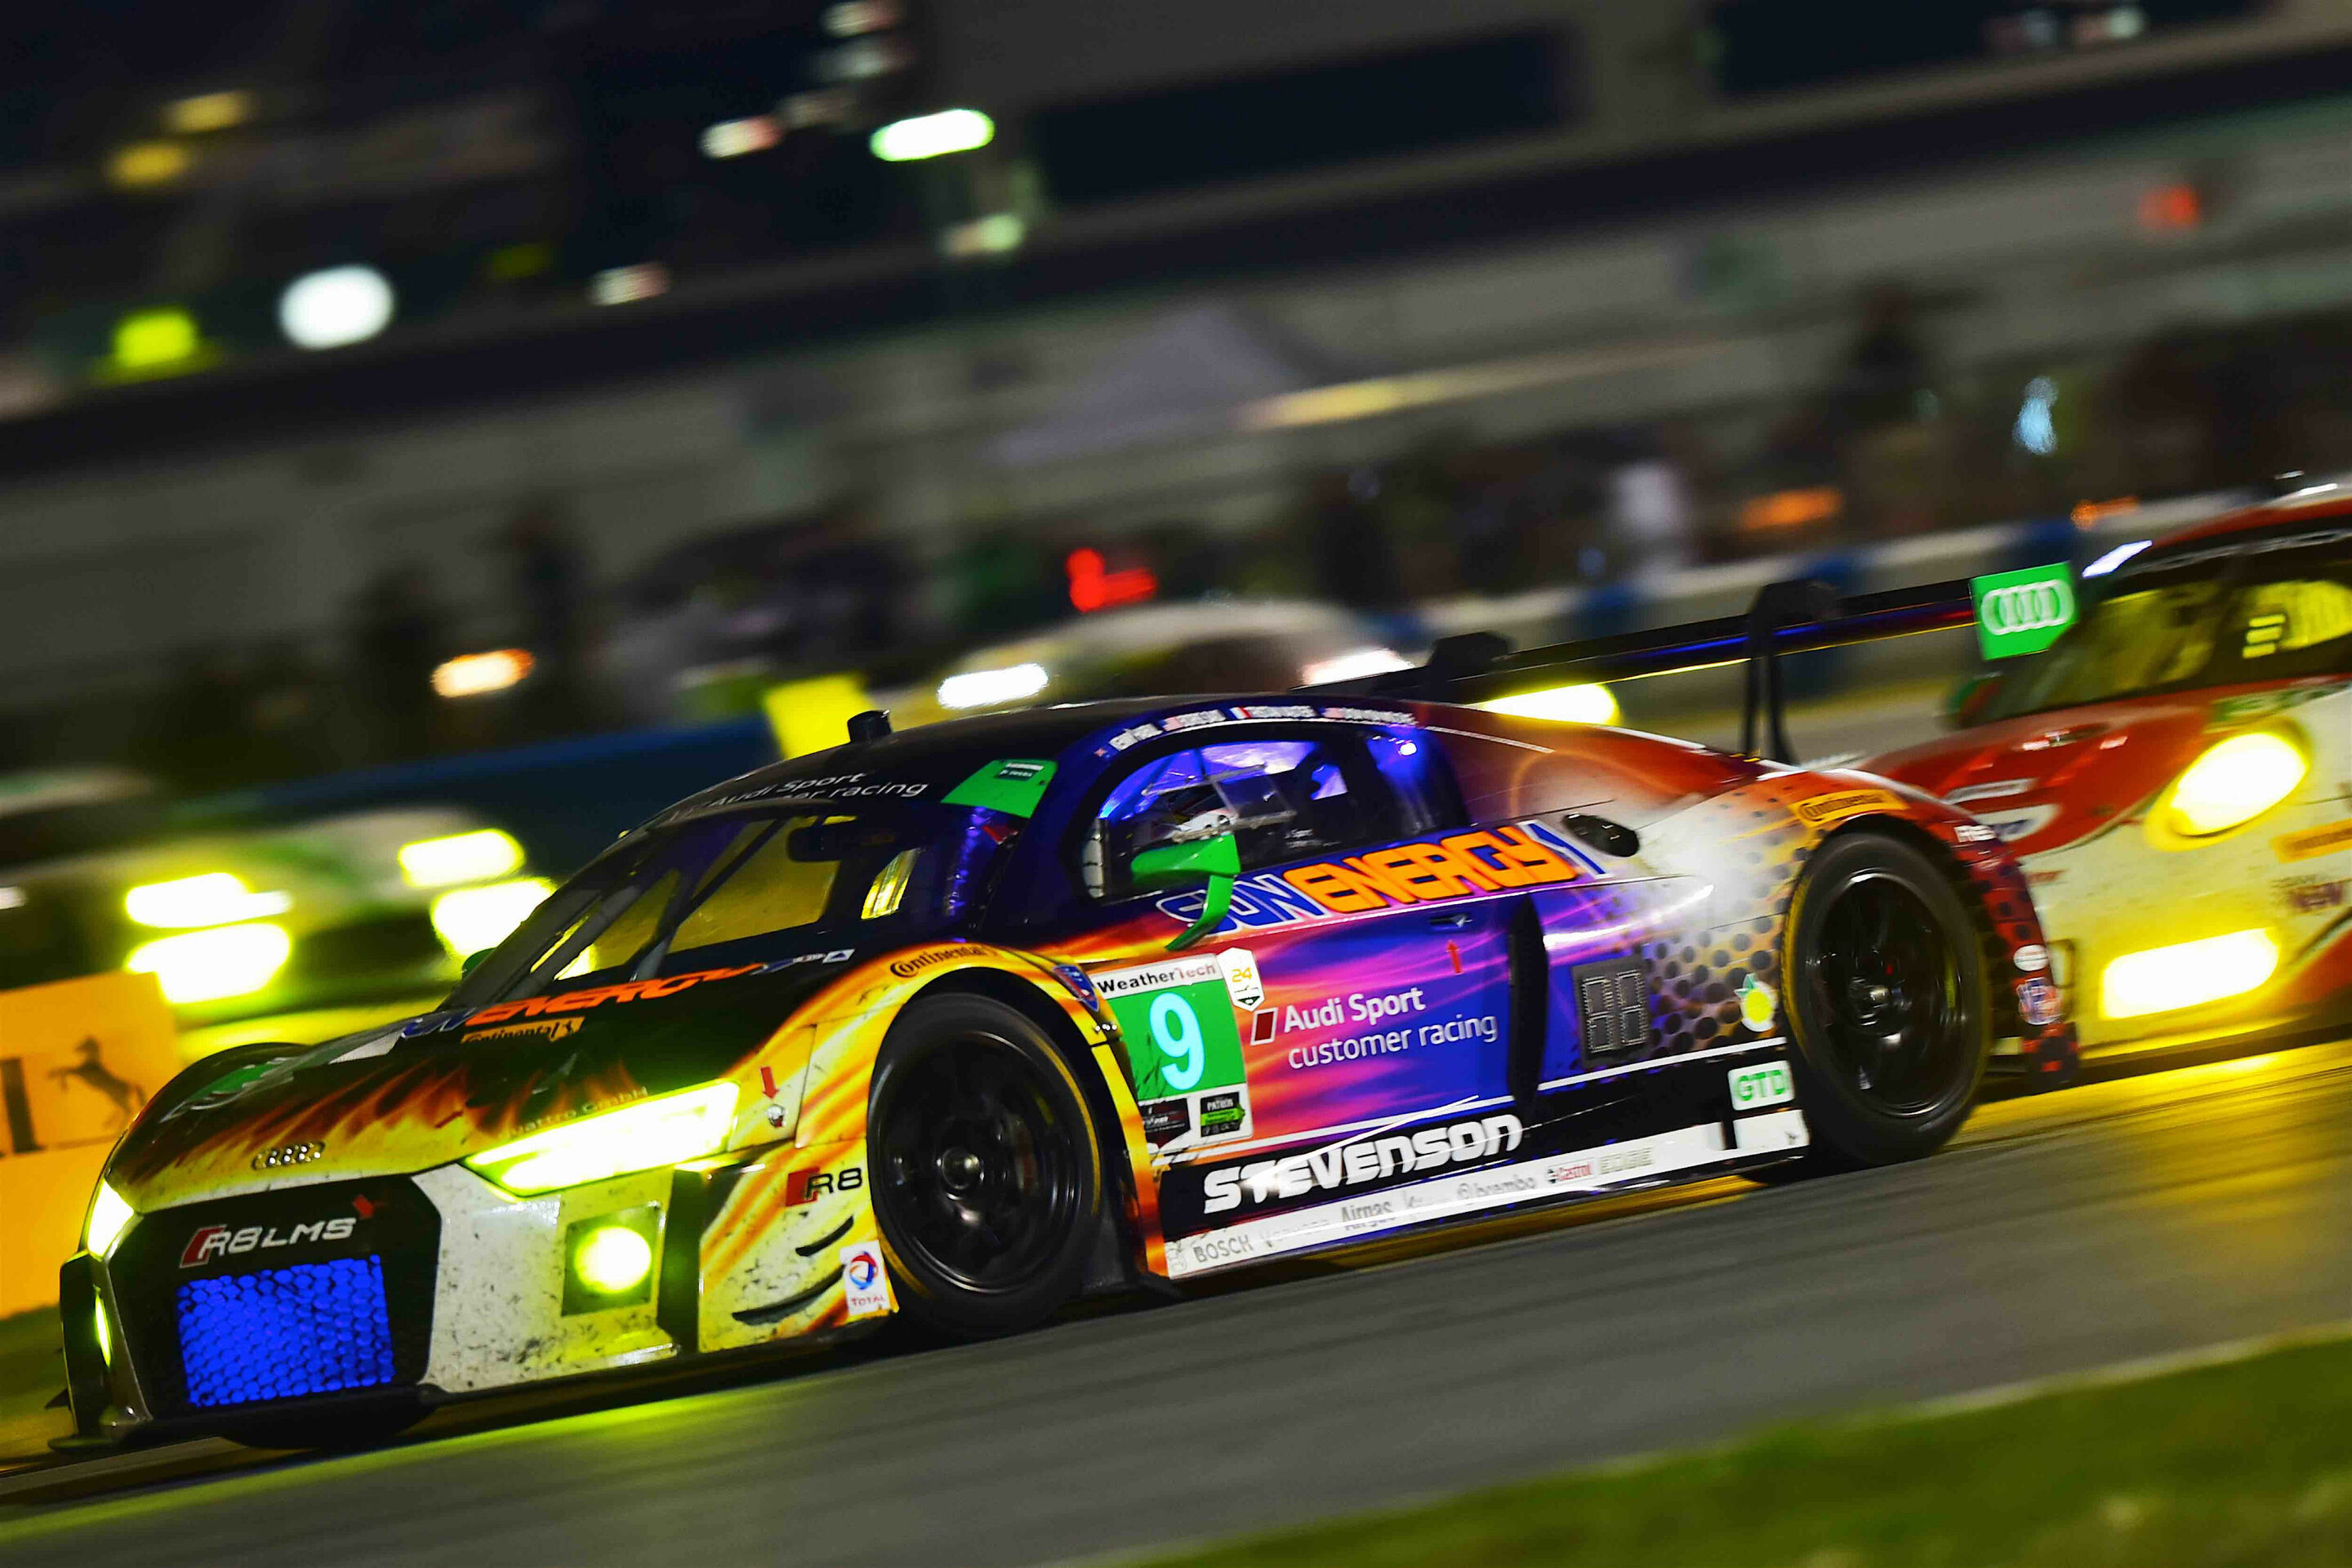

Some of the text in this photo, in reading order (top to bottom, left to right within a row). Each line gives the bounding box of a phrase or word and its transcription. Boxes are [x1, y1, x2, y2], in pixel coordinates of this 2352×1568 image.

[777, 772, 867, 793] Sport
[827, 781, 929, 799] racing
[1097, 963, 1217, 994] WeatherTech
[1232, 967, 1253, 982] 24
[1284, 987, 1427, 1034] Audi Sport
[1149, 991, 1205, 1091] 9
[1288, 1013, 1499, 1071] customer racing
[1735, 1068, 1788, 1102] GTD
[1203, 1113, 1524, 1215] STEVENSON
[804, 1167, 863, 1200] R8
[198, 1217, 358, 1260] R8 LMS
[1193, 1235, 1254, 1263] BOSCH
